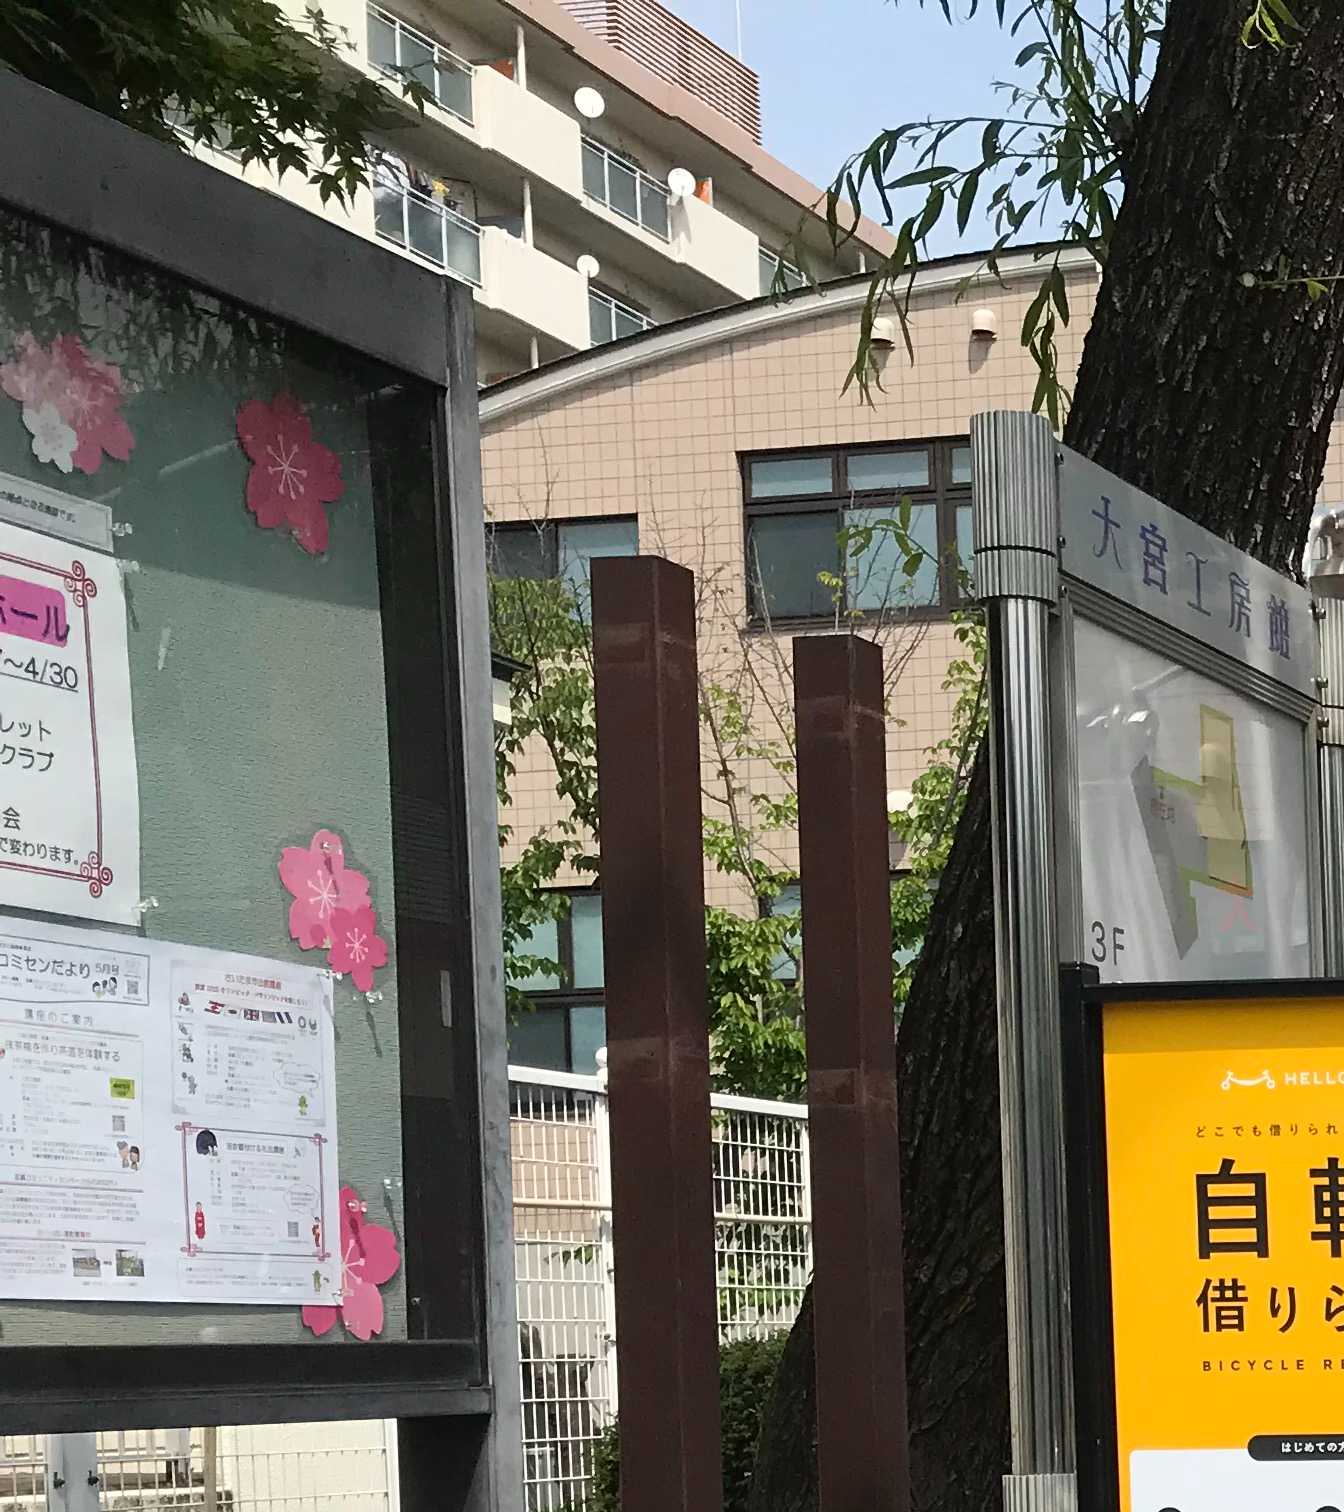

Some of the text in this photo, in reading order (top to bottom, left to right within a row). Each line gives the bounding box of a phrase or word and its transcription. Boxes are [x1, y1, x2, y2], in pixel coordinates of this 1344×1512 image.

[1091, 495, 1291, 660] 大宮工房館
[1091, 920, 1125, 967] 3F
[1202, 1359, 1305, 1372] BICYCLE
